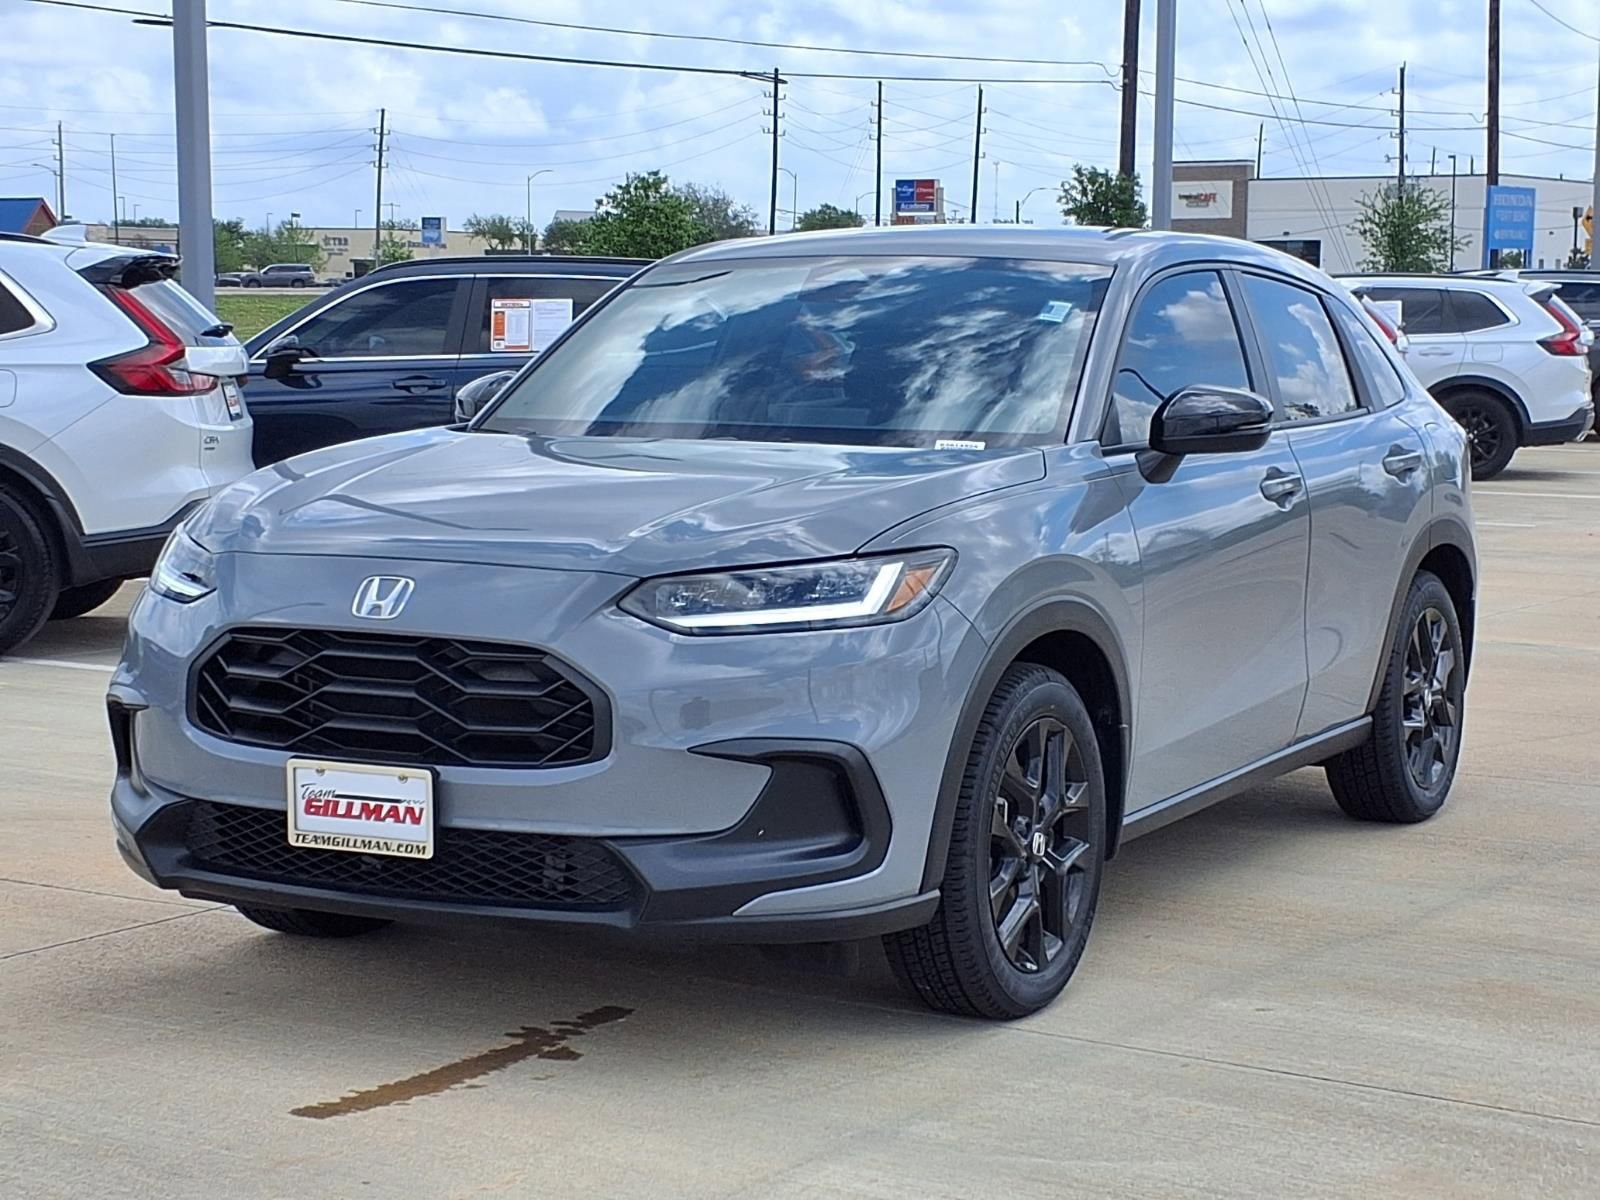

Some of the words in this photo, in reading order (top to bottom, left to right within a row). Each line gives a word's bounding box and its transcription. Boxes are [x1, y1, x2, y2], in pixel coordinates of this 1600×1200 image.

[300, 782, 337, 801] Team
[303, 799, 424, 826] GILLMAN
[294, 833, 427, 856] TEAMGILLMAN.COM
